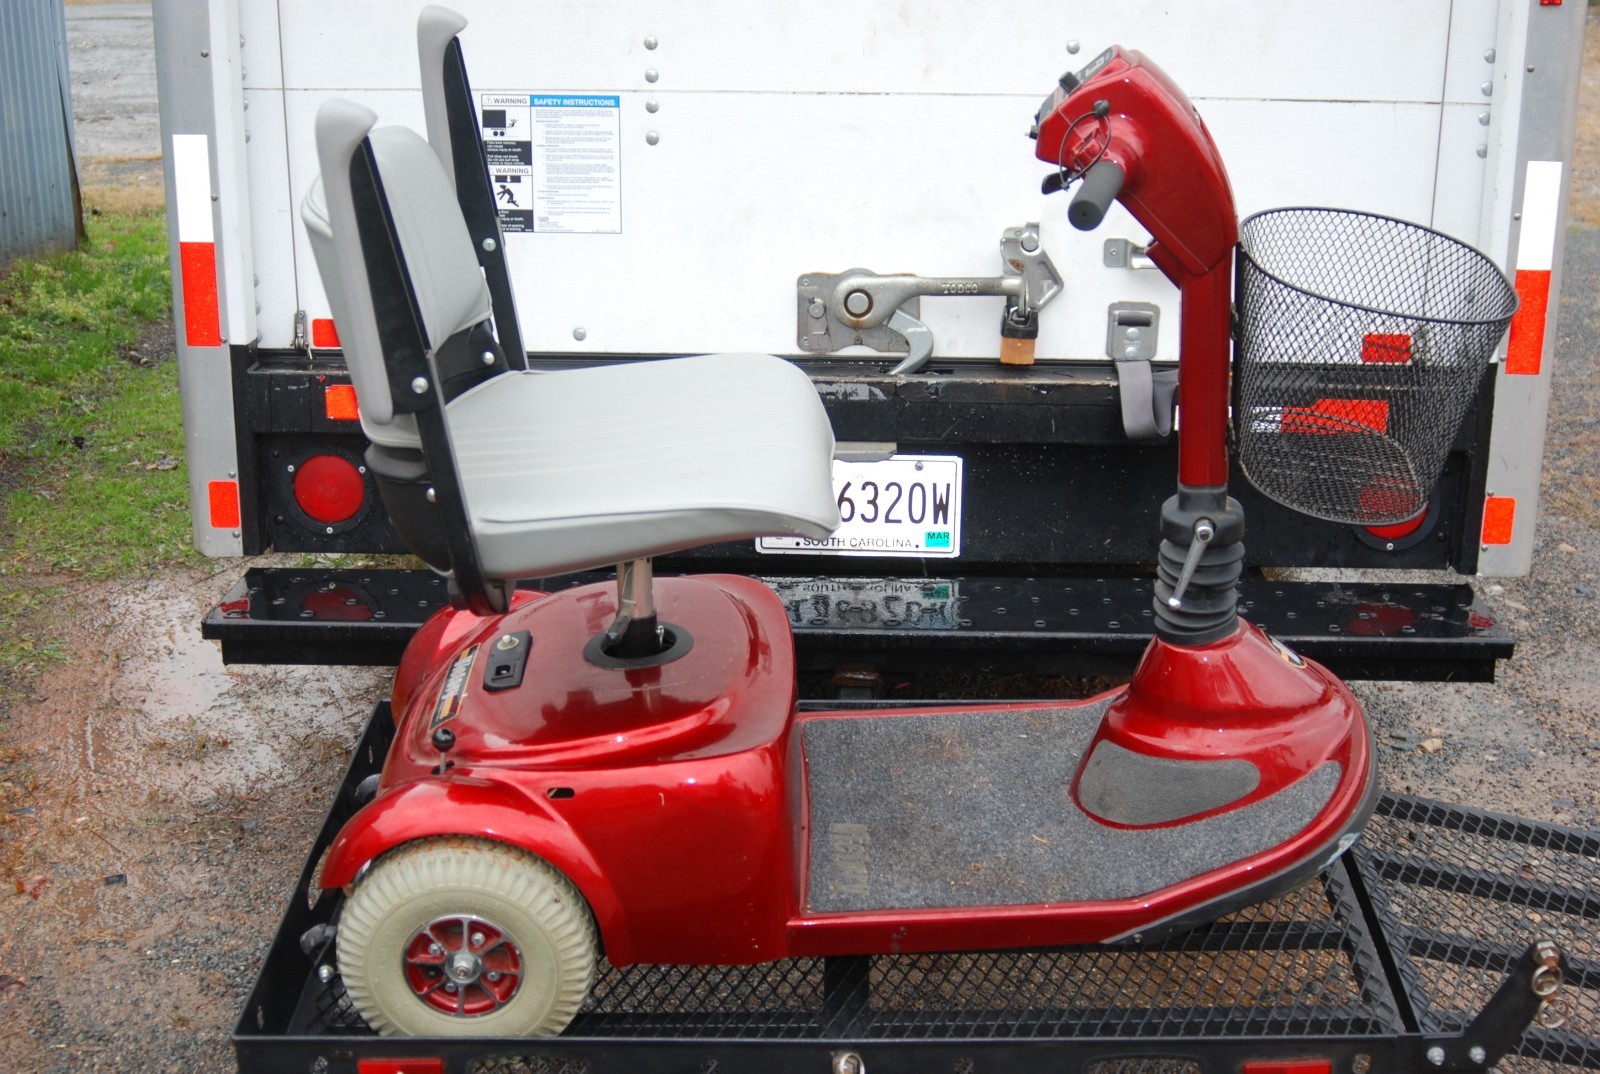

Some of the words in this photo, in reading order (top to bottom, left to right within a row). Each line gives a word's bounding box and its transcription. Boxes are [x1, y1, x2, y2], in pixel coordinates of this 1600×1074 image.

[562, 98, 616, 106] INSTRUCTIONS
[942, 283, 979, 294] TODCO
[837, 481, 951, 525] 6320W
[927, 532, 950, 540] MAR
[803, 537, 846, 547] SOUTH
[849, 537, 912, 548] CAROLINA
